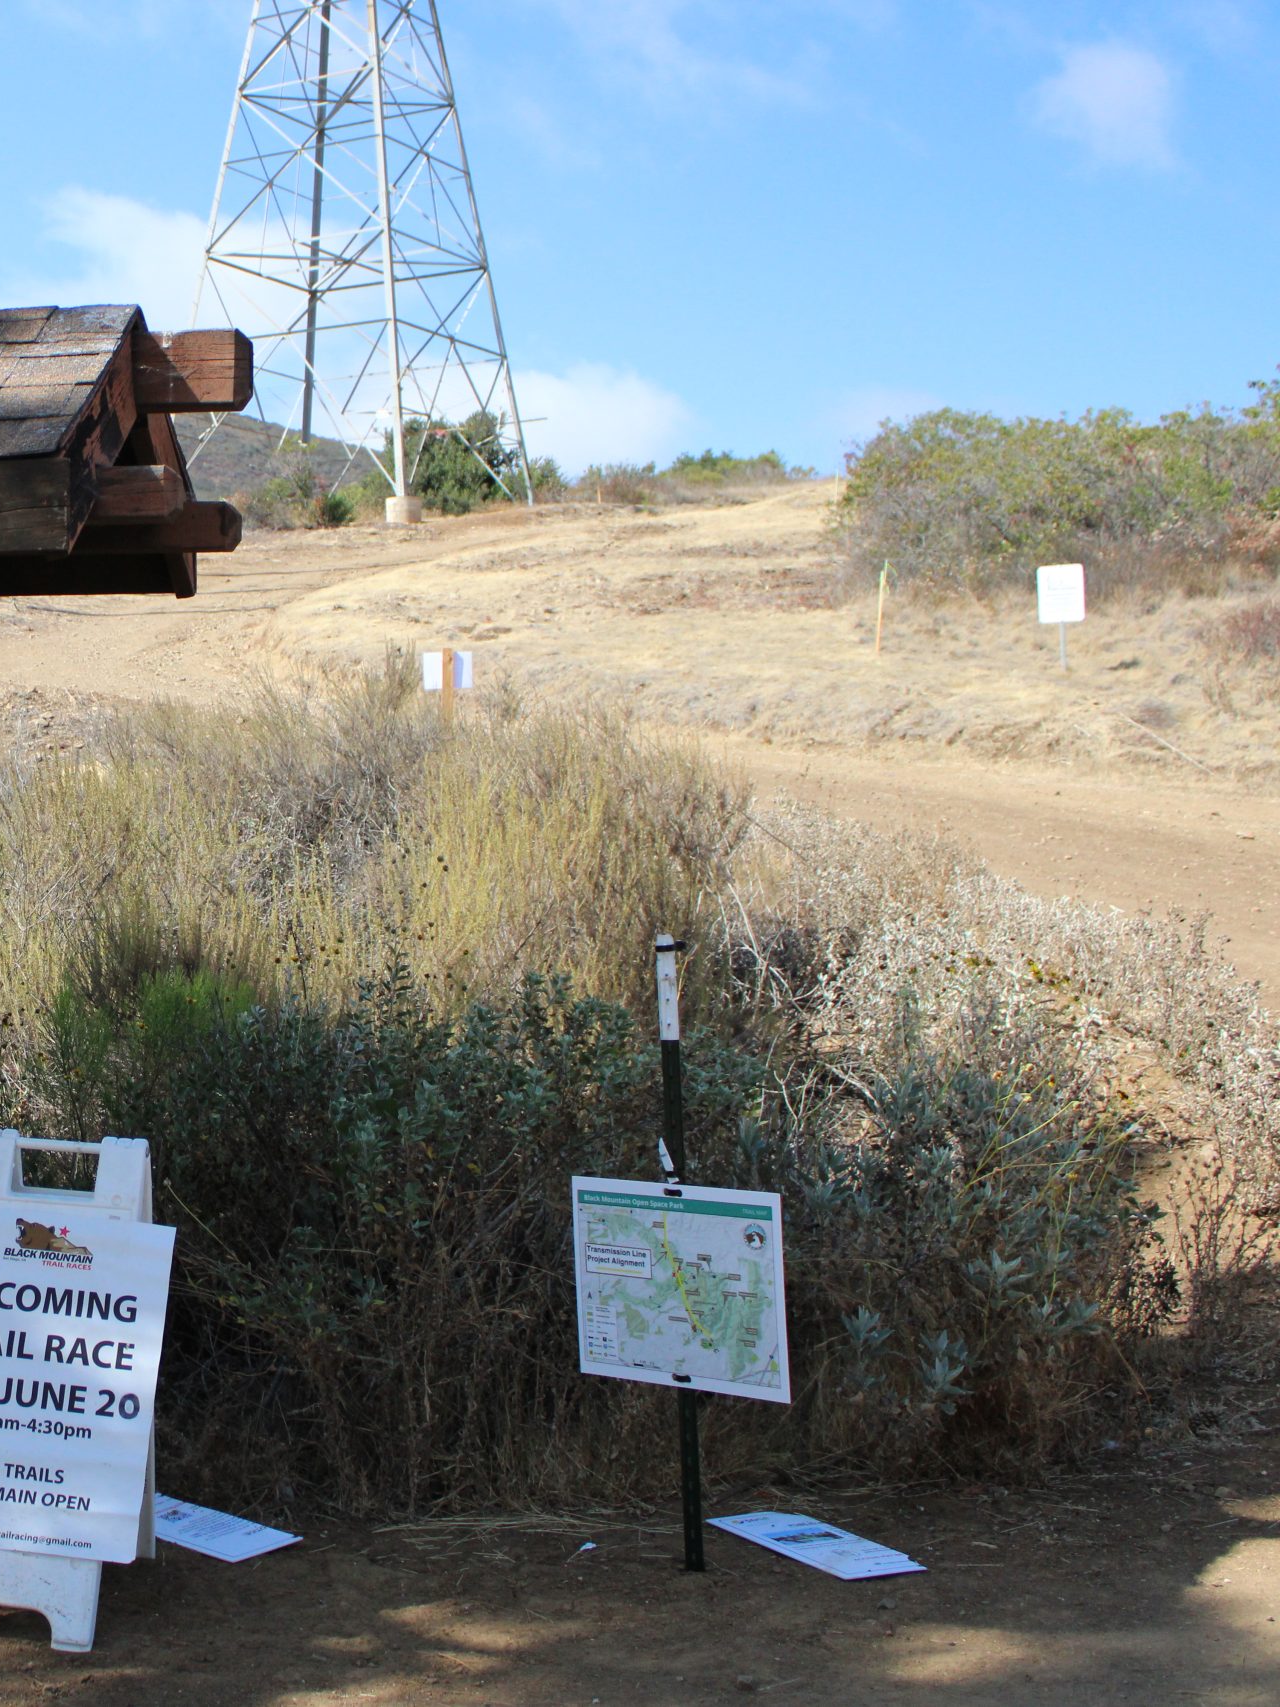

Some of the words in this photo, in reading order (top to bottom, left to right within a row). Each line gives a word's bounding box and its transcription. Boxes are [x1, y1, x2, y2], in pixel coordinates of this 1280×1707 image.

[583, 1194, 601, 1202] Black
[602, 1195, 631, 1204] Mountain
[632, 1198, 649, 1207] Open
[650, 1200, 668, 1208] Space
[3, 1247, 39, 1259] BLACK
[39, 1251, 94, 1264] MOUNTAIN
[587, 1245, 631, 1257] Transmission
[632, 1250, 647, 1258] Line
[42, 1260, 65, 1268] TRAIL
[66, 1263, 92, 1271] RACES
[587, 1255, 610, 1264] Project
[611, 1257, 645, 1268] Alignment
[44, 1334, 135, 1371] RACE
[95, 1389, 140, 1420] 20
[4, 1463, 65, 1484] TRAILS
[41, 1492, 91, 1511] OPEN
